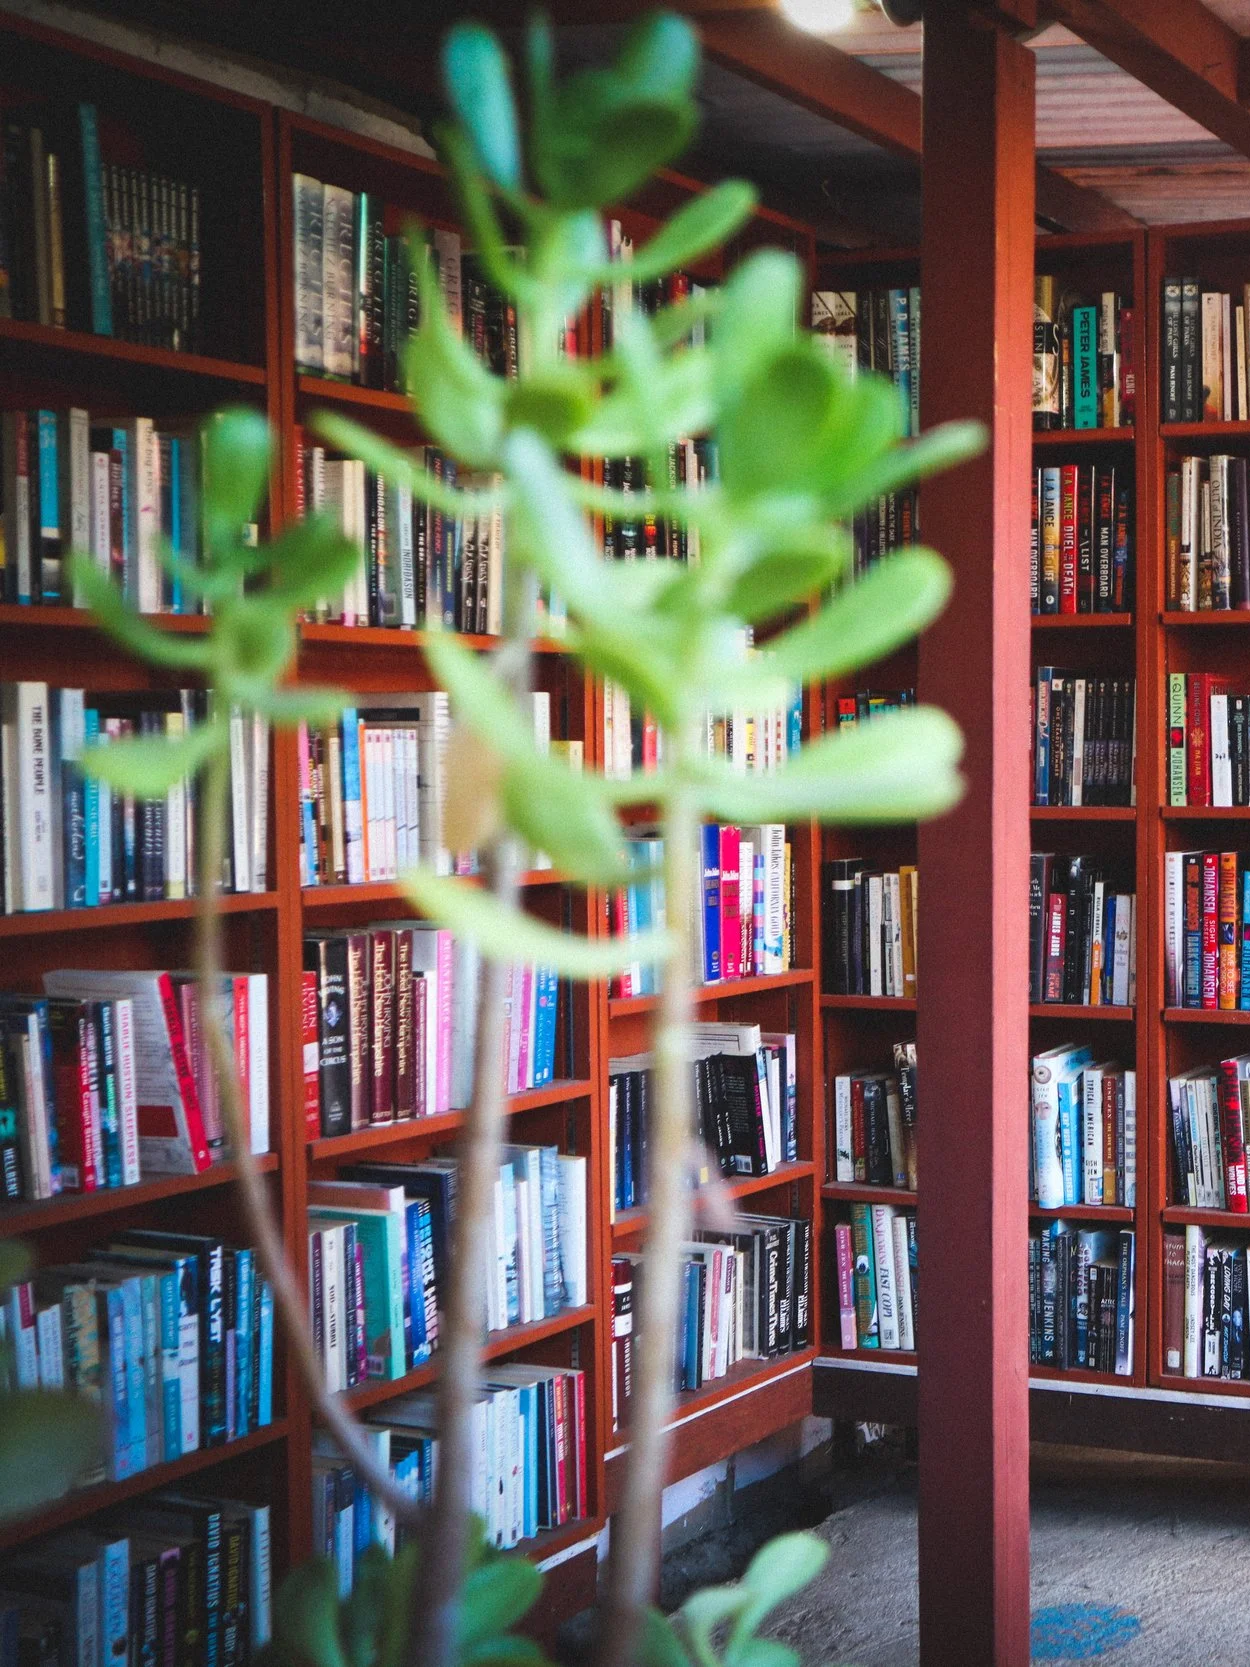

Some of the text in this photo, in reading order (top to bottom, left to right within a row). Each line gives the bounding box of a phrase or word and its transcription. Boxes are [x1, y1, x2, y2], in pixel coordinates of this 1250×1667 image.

[326, 272, 336, 340] BURNING
[898, 331, 910, 372] JAMES
[1080, 312, 1091, 398] PETER JAMES
[1044, 496, 1054, 528] JANCE
[1212, 480, 1222, 502] OUT
[1063, 492, 1074, 594] JANCE DUEL DEATH
[1212, 514, 1222, 549] INDIA
[402, 548, 413, 599] INDRIDASON
[1044, 566, 1054, 582] LIFE
[1081, 548, 1089, 570] LIST
[1100, 527, 1108, 597] MAN OVERBOARD
[32, 706, 44, 796] THE BONE PEOPLE
[1172, 682, 1182, 796] QUINN JOHANSEN
[70, 791, 84, 860] motherland
[770, 829, 783, 847] John
[770, 850, 783, 870] Jakes
[770, 872, 780, 914] CALIFORNIA
[1203, 866, 1216, 914] JOHANSEN
[1220, 866, 1234, 918] JOHANSEN
[1051, 912, 1062, 933] JAMES
[350, 966, 362, 999] Hotel
[396, 959, 408, 992] Hotel
[441, 939, 450, 1024] SUSAN ISAACS
[1187, 936, 1200, 995] DARK SUMMER
[1203, 950, 1216, 998] JOHANSEN
[1228, 968, 1234, 978] TO
[307, 986, 316, 1028] JOHN
[350, 1001, 362, 1025] New
[371, 943, 384, 1076] The Hotel New Hampshire
[396, 994, 408, 1017] New
[102, 1006, 113, 1066] Charlie HUSTON
[348, 1027, 362, 1084] Hampshire
[394, 1020, 408, 1076] Hampshire
[122, 1006, 136, 1165] CHARLIE HUSTON SLEEPLESS
[1086, 1080, 1094, 1104] TYPICAL
[82, 1092, 93, 1167] Caught Stealing
[5, 1148, 18, 1196] HELLBENT
[1228, 1166, 1237, 1196] WOLVES
[1236, 1165, 1246, 1196] LAND OF
[1042, 1230, 1050, 1262] WAKING
[768, 1250, 778, 1346] Crime Times Three
[879, 1268, 892, 1318] FAST COPY
[1044, 1300, 1054, 1342] JENKINS
[207, 1513, 220, 1609] DAVID IGNATIUS
[144, 1564, 156, 1642] DAVID IGNATIUS
